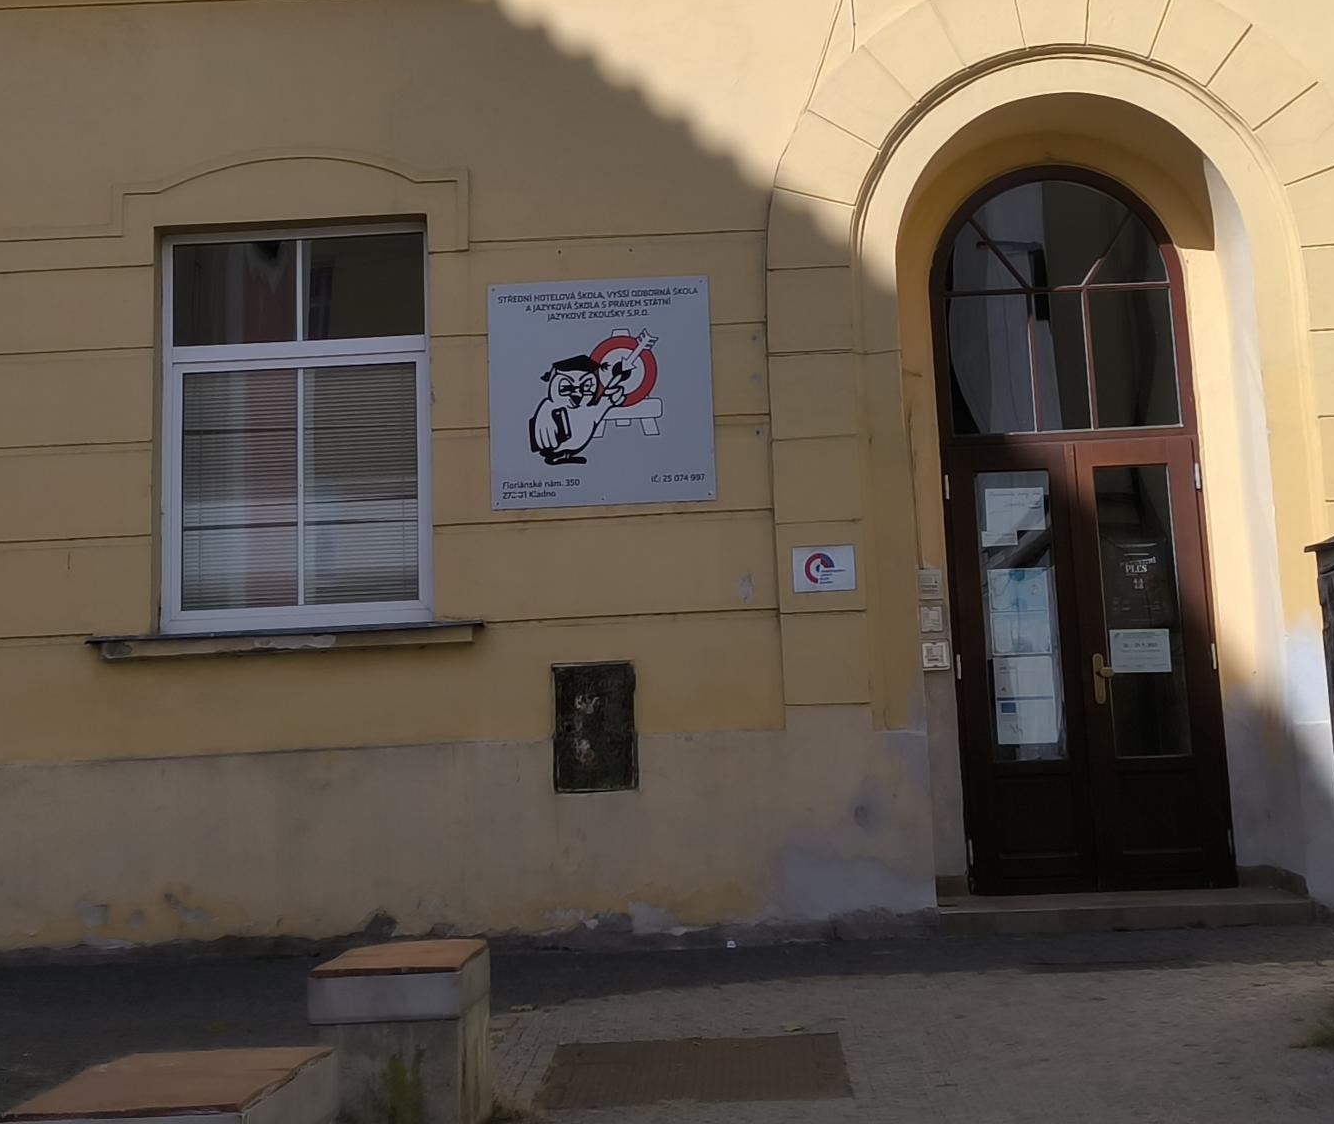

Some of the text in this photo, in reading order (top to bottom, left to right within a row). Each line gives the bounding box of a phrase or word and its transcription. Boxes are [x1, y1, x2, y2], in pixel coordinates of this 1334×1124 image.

[497, 286, 699, 304] STŘEDNÍ HOTELOVÁ ŠKOLA, VYŠŠÍ ODBORNÁ ŠKOLA
[525, 296, 672, 313] A JAZYKOVÁ ŠKOLA S PRÁVEM STÁTNÍ
[547, 310, 587, 322] JAZYKOVÉ
[588, 308, 626, 319] ZKOUŠKY
[565, 478, 581, 487] 350
[663, 474, 673, 483] 25
[673, 473, 689, 482] 074
[690, 472, 706, 482] 997
